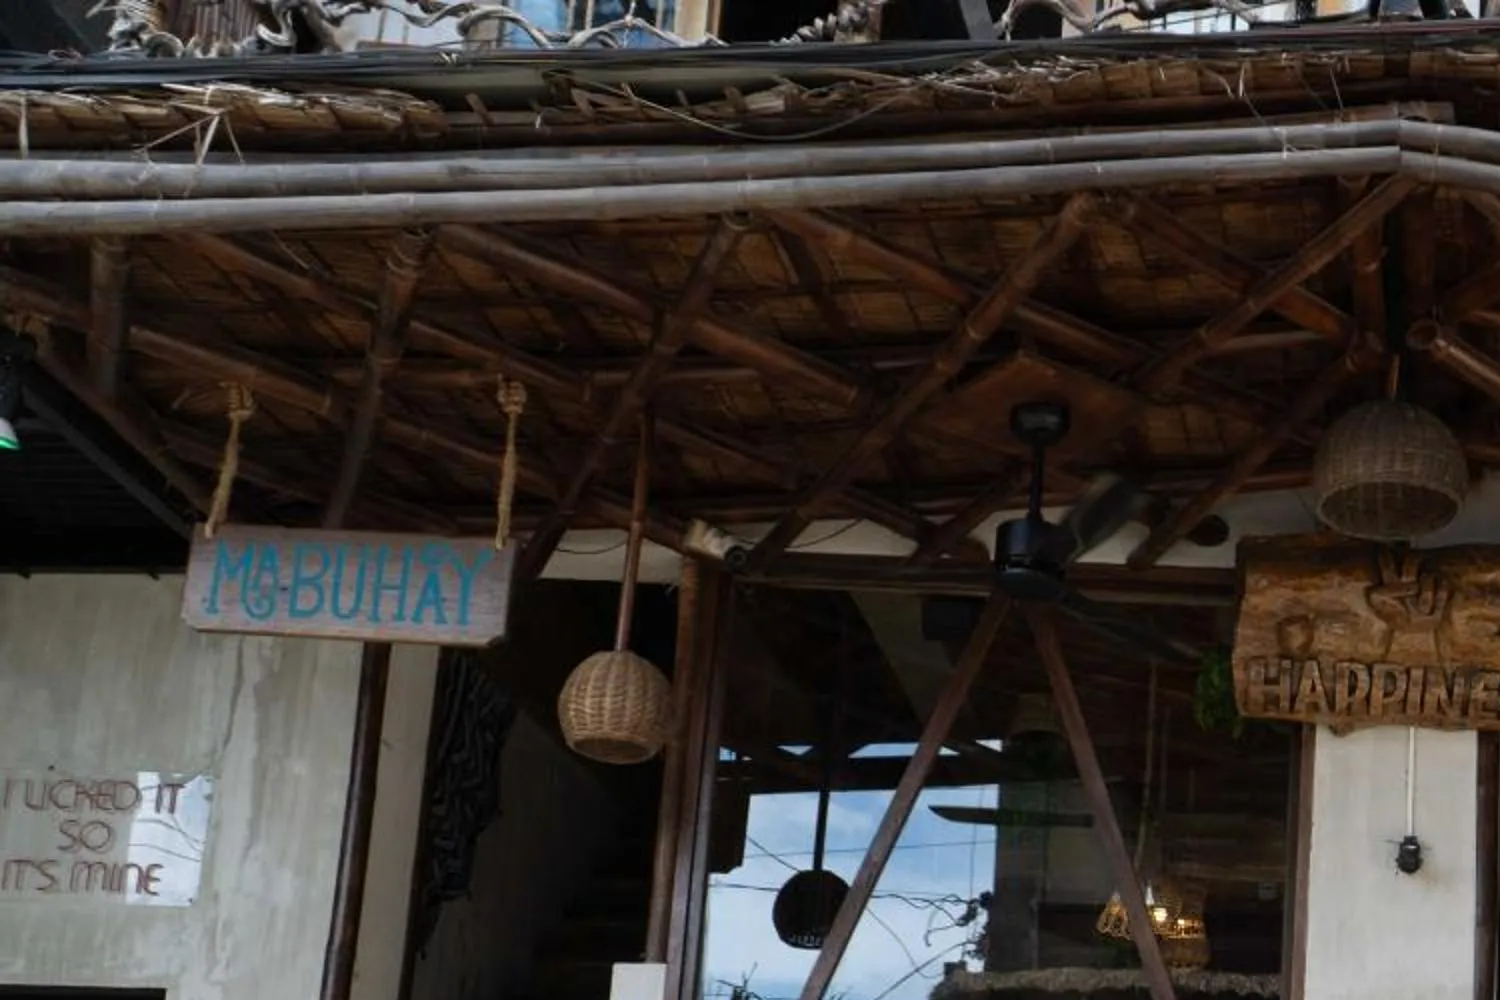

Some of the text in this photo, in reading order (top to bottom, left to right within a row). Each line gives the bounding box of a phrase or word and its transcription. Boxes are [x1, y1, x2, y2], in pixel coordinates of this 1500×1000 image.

[204, 539, 496, 627] MABUHAY
[155, 783, 184, 814] IT
[57, 819, 112, 852] SO
